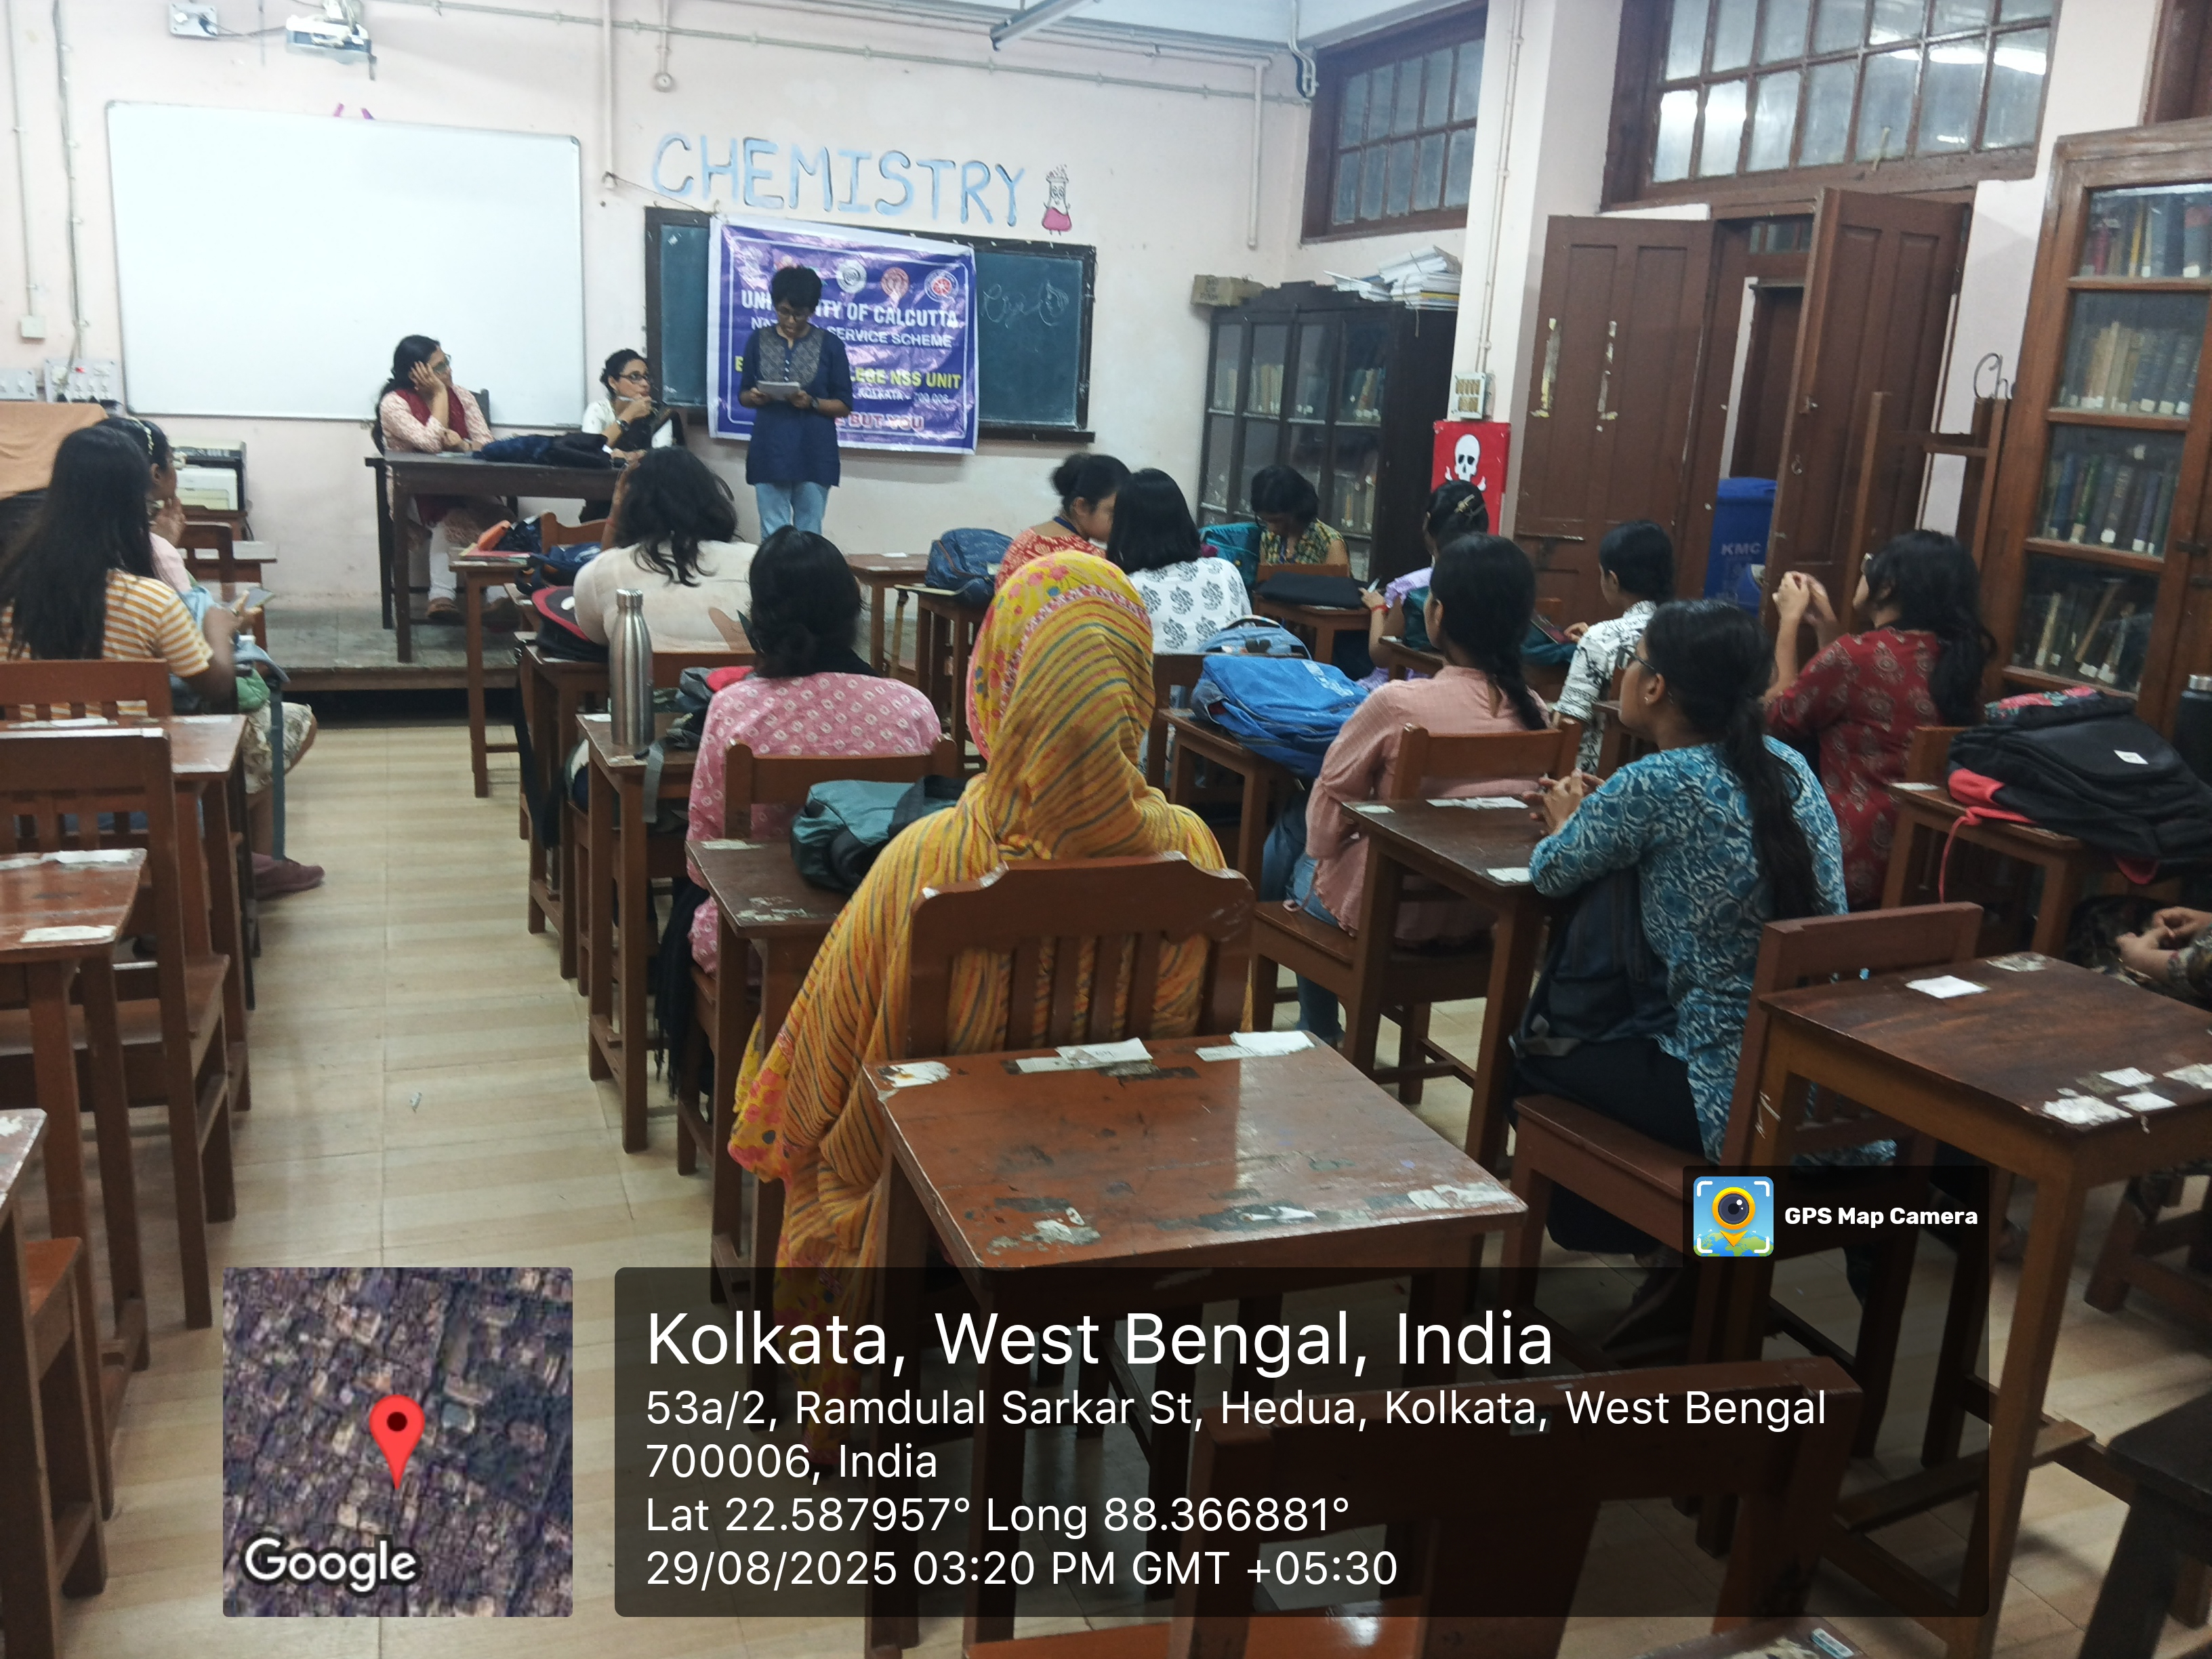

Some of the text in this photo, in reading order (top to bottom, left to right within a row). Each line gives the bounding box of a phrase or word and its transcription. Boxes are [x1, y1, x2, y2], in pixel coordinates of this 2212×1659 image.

[651, 132, 1025, 228] CHEMISTRY
[847, 303, 868, 322] OF
[874, 306, 958, 328] CALCUTTA
[891, 332, 952, 348] SCHEME
[890, 369, 922, 387] NSS
[926, 373, 962, 389] UNIT
[848, 411, 884, 428] BUT
[886, 413, 924, 432] YOU
[1721, 543, 1761, 555] KMC
